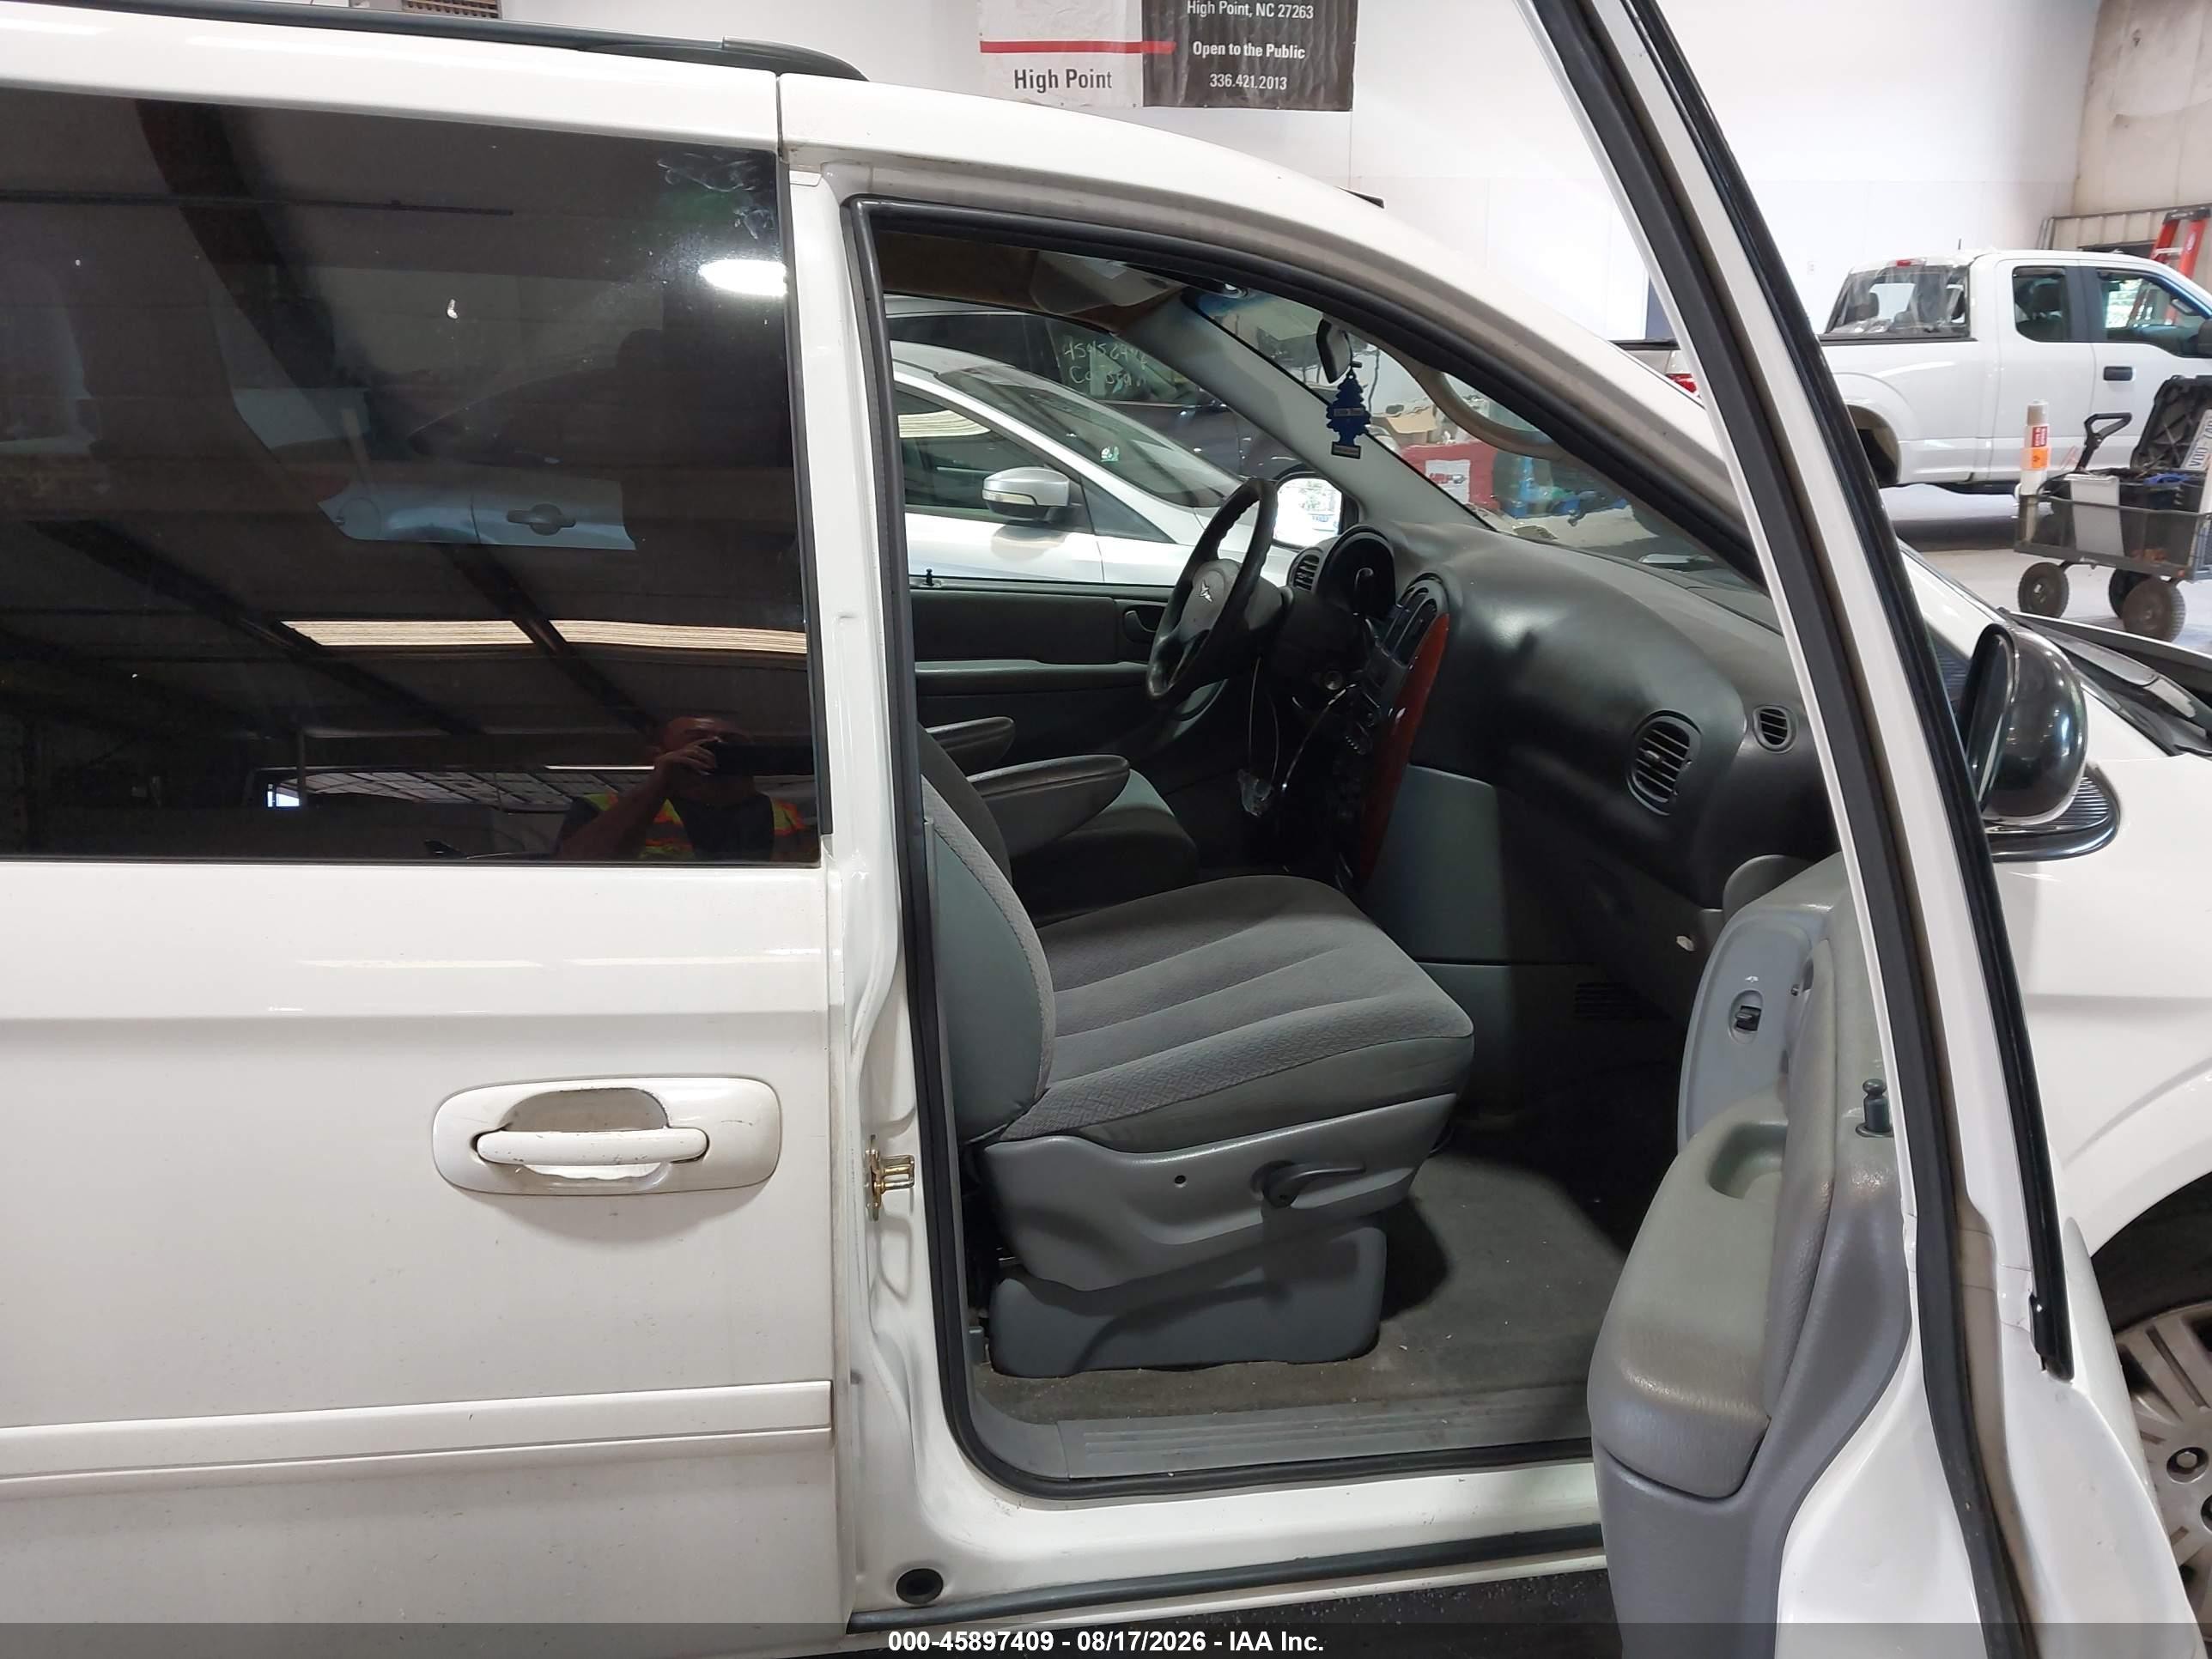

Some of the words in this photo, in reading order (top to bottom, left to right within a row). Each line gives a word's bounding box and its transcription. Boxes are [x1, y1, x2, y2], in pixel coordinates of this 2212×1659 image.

[1187, 0, 1215, 17] High
[1218, 1, 1253, 18] Point,
[1255, 3, 1275, 17] NC
[1277, 3, 1314, 19] 27263
[1193, 40, 1226, 59] Open
[1229, 43, 1242, 56] to
[1243, 43, 1263, 57] the
[1266, 43, 1306, 59] Public
[1014, 69, 1059, 94] High
[1066, 68, 1113, 88] Point
[1209, 73, 1288, 90] 336.421.2013
